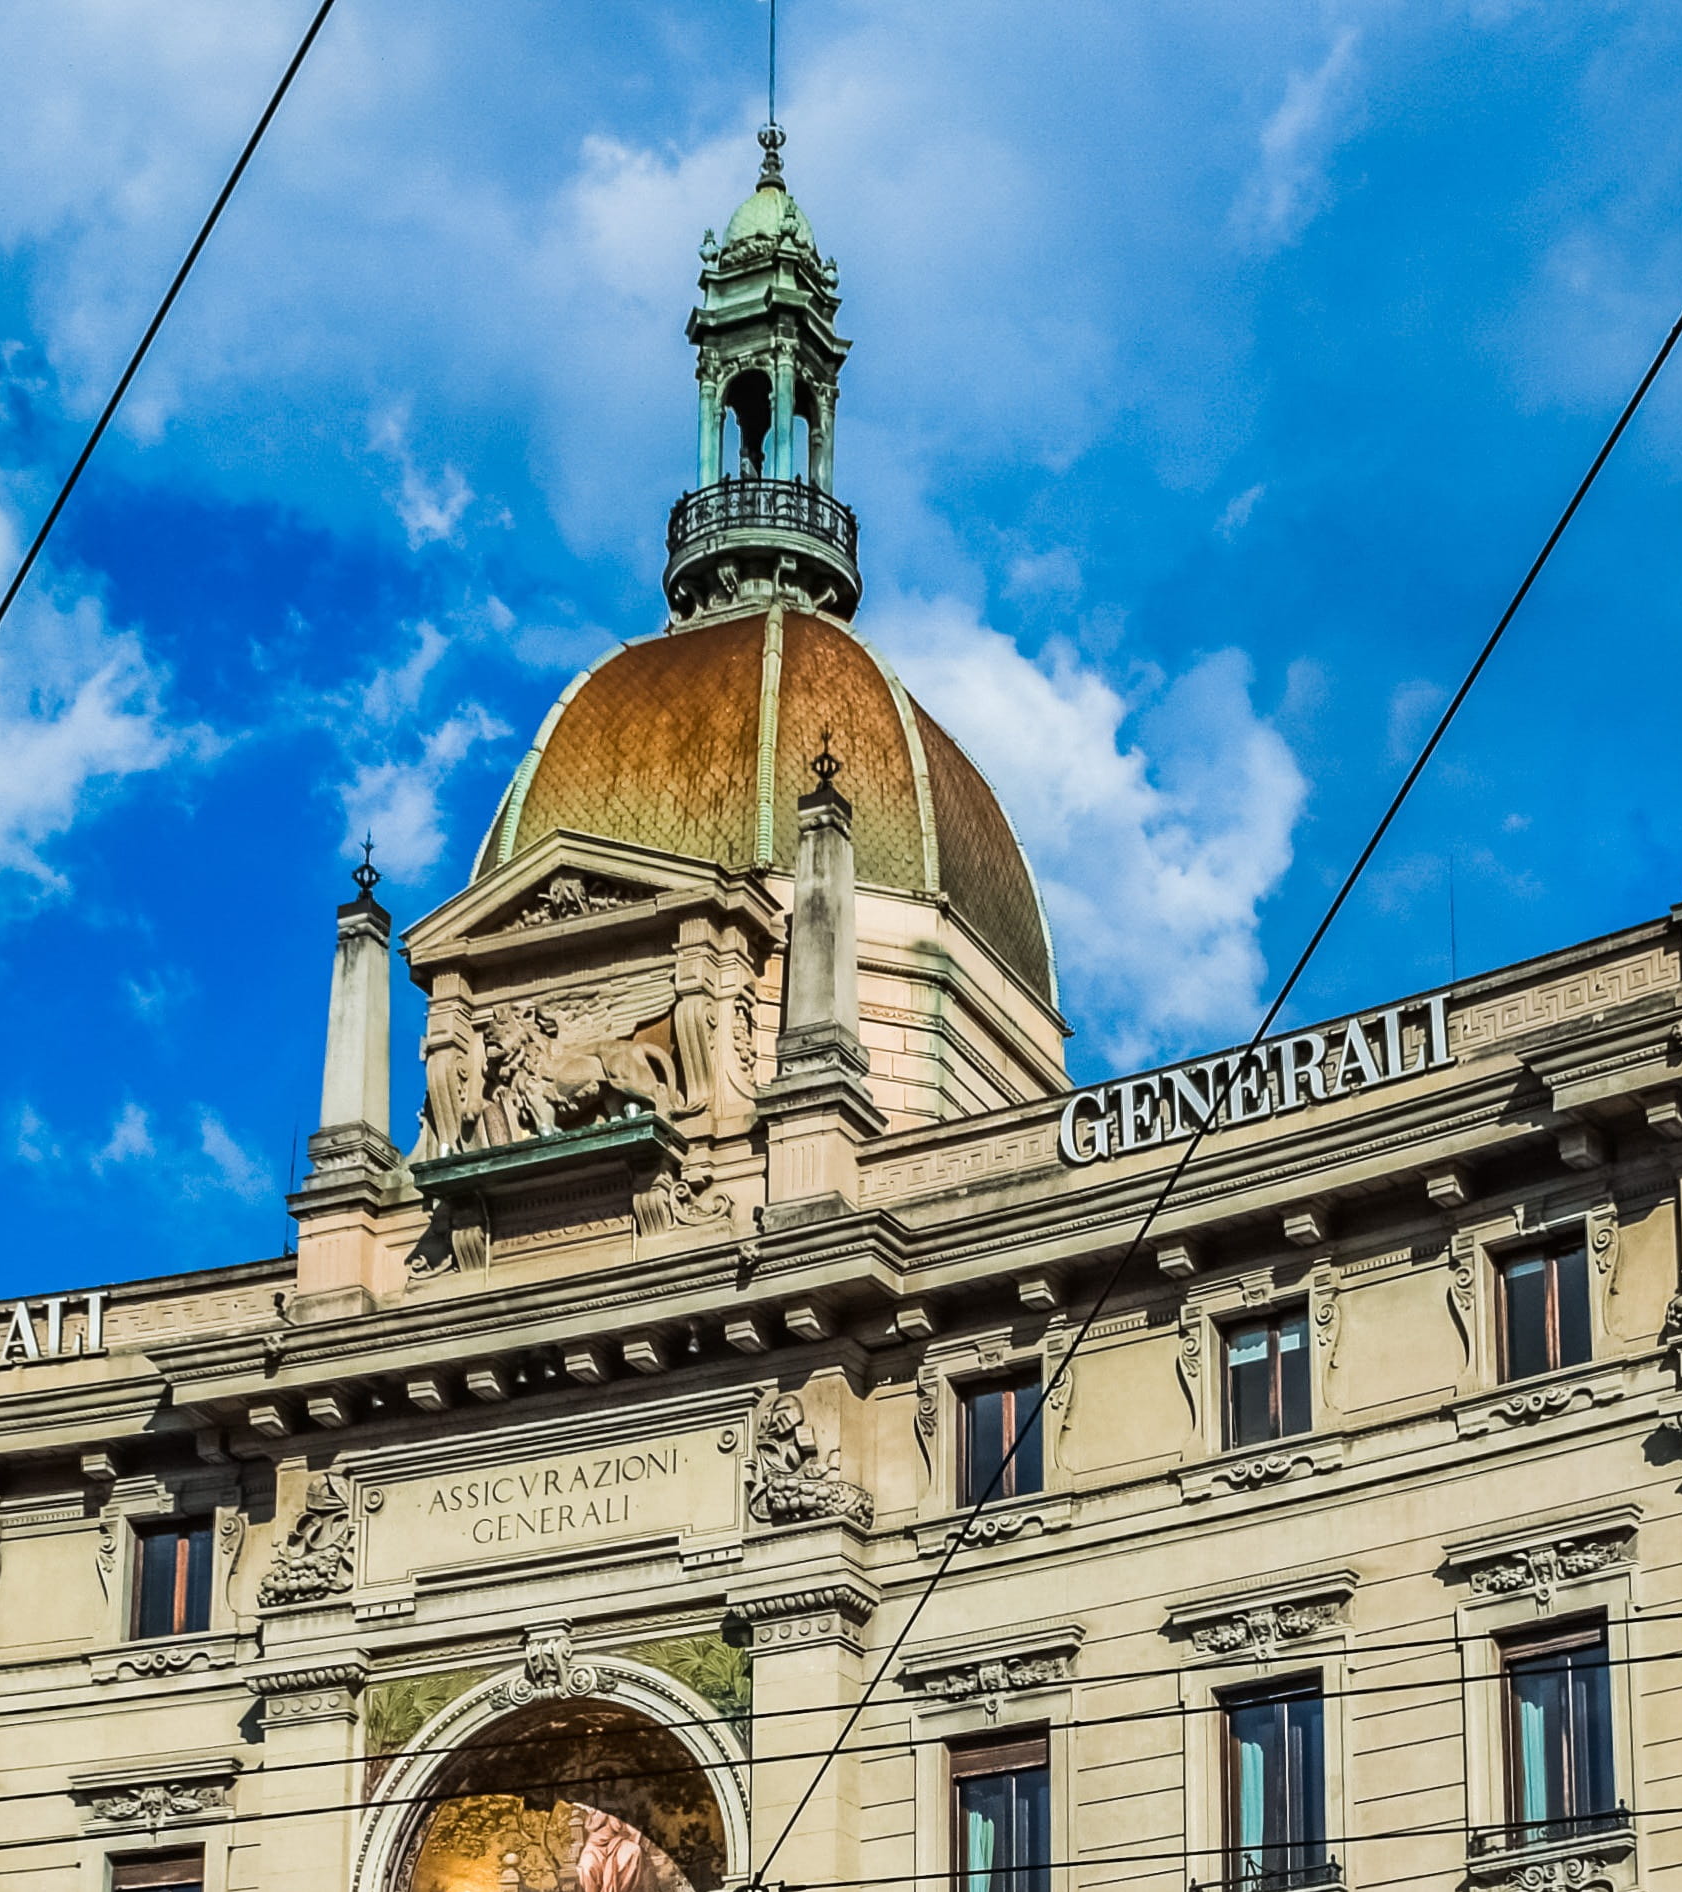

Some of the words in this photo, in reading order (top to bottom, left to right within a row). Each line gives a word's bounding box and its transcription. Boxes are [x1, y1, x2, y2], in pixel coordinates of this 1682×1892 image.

[1060, 991, 1456, 1163] GENERALI
[428, 1448, 678, 1515] ASSICVRAZIONI
[472, 1494, 629, 1544] GENERALI
